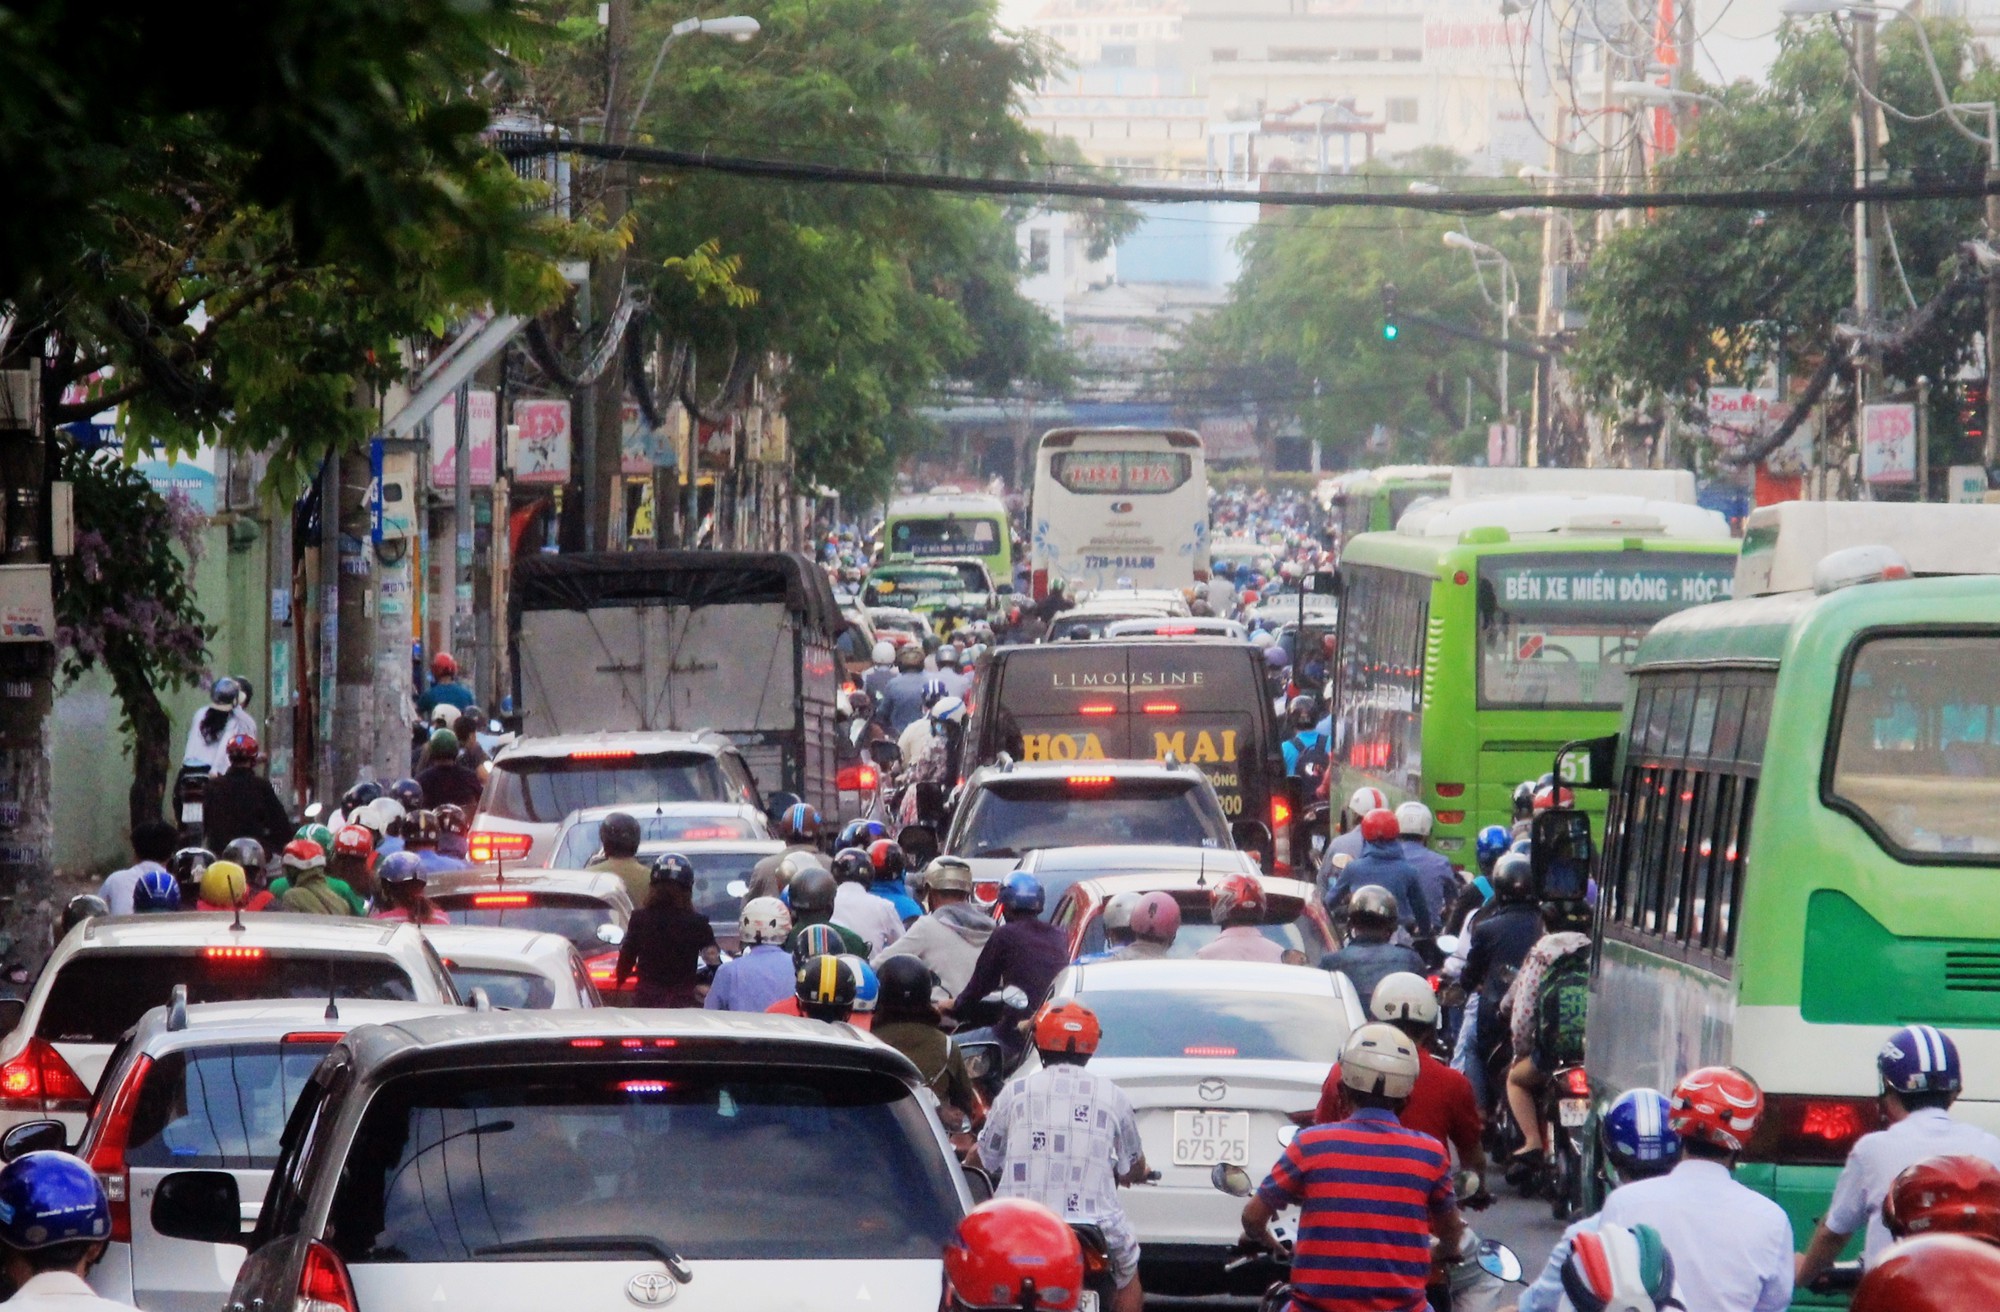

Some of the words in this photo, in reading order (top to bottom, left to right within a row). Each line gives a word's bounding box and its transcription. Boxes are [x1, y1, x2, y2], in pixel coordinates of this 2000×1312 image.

[1505, 569, 1541, 600] BẾN
[1546, 577, 1569, 600] XE
[1573, 569, 1616, 600] MIỀN
[1620, 572, 1667, 600] ĐÔNG
[1682, 572, 1718, 600] HÓC
[1053, 672, 1204, 686] LIMOUSINE
[1022, 732, 1106, 761] HOA
[1154, 730, 1238, 763] MAI
[1192, 1115, 1230, 1138] 51F
[1177, 1139, 1245, 1161] 675.25
